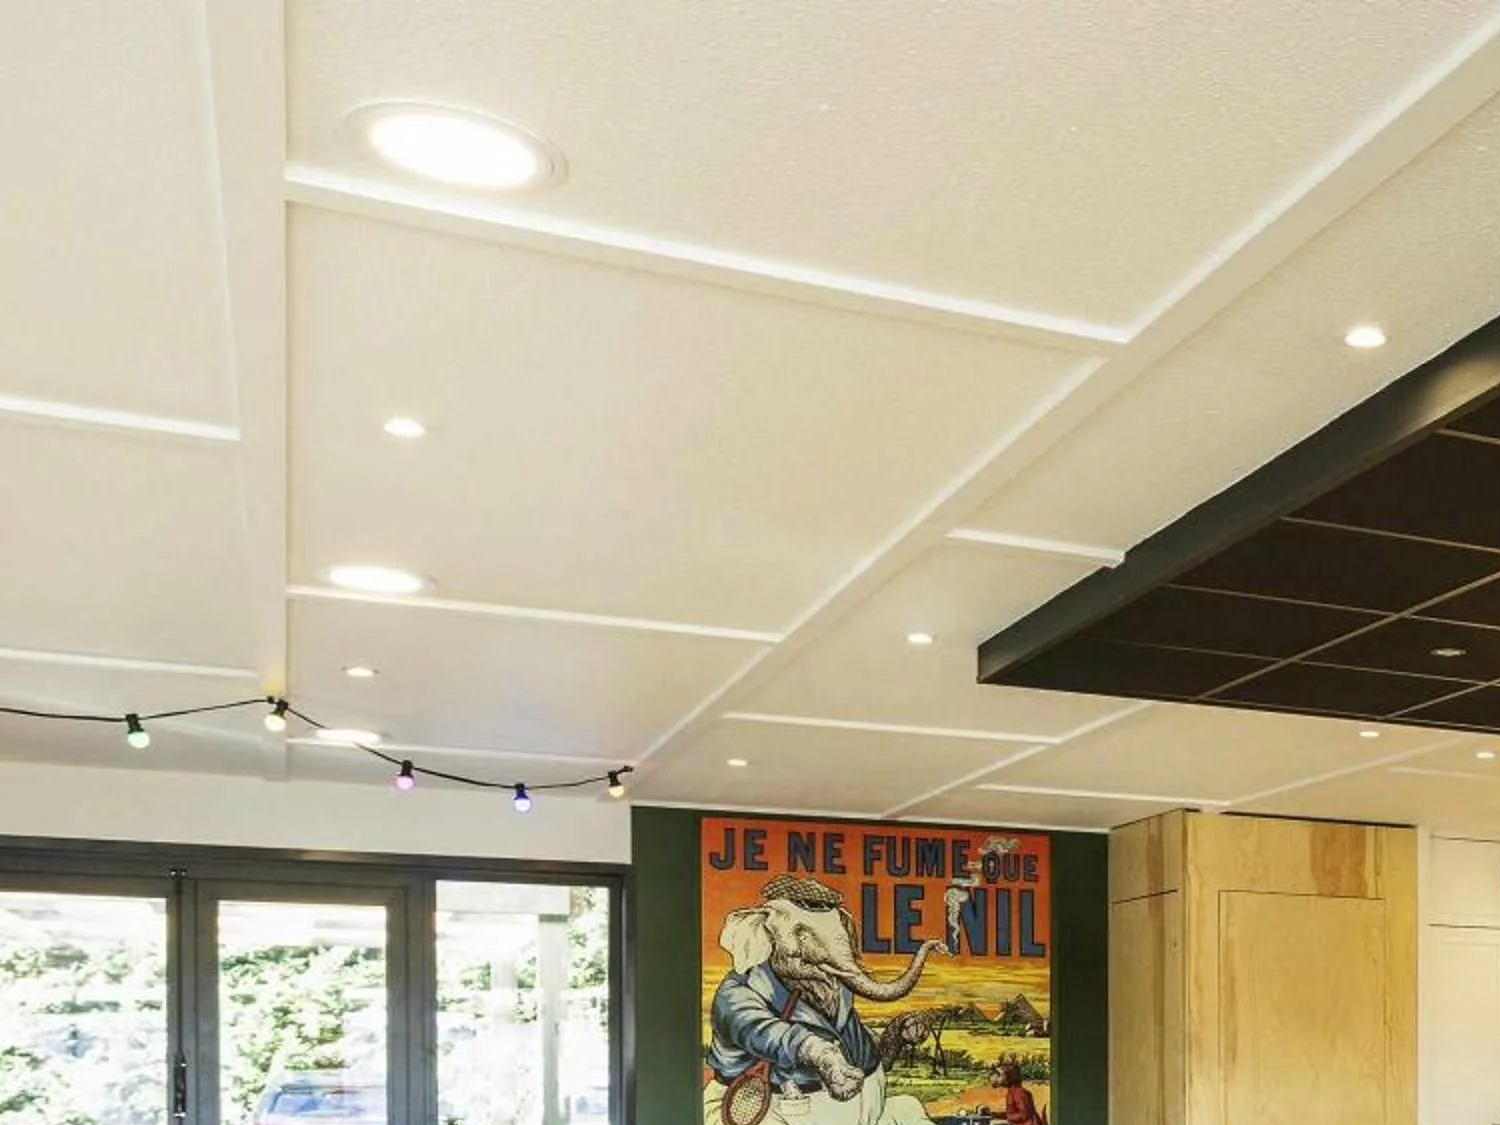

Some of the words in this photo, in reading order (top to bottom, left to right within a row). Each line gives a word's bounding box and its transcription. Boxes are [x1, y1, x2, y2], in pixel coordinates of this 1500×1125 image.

[709, 828, 769, 871] JE
[787, 831, 847, 874] NE
[863, 835, 971, 879] FUME
[981, 850, 1039, 884] QUE
[861, 883, 924, 955] LE
[945, 885, 1046, 958] NIL
